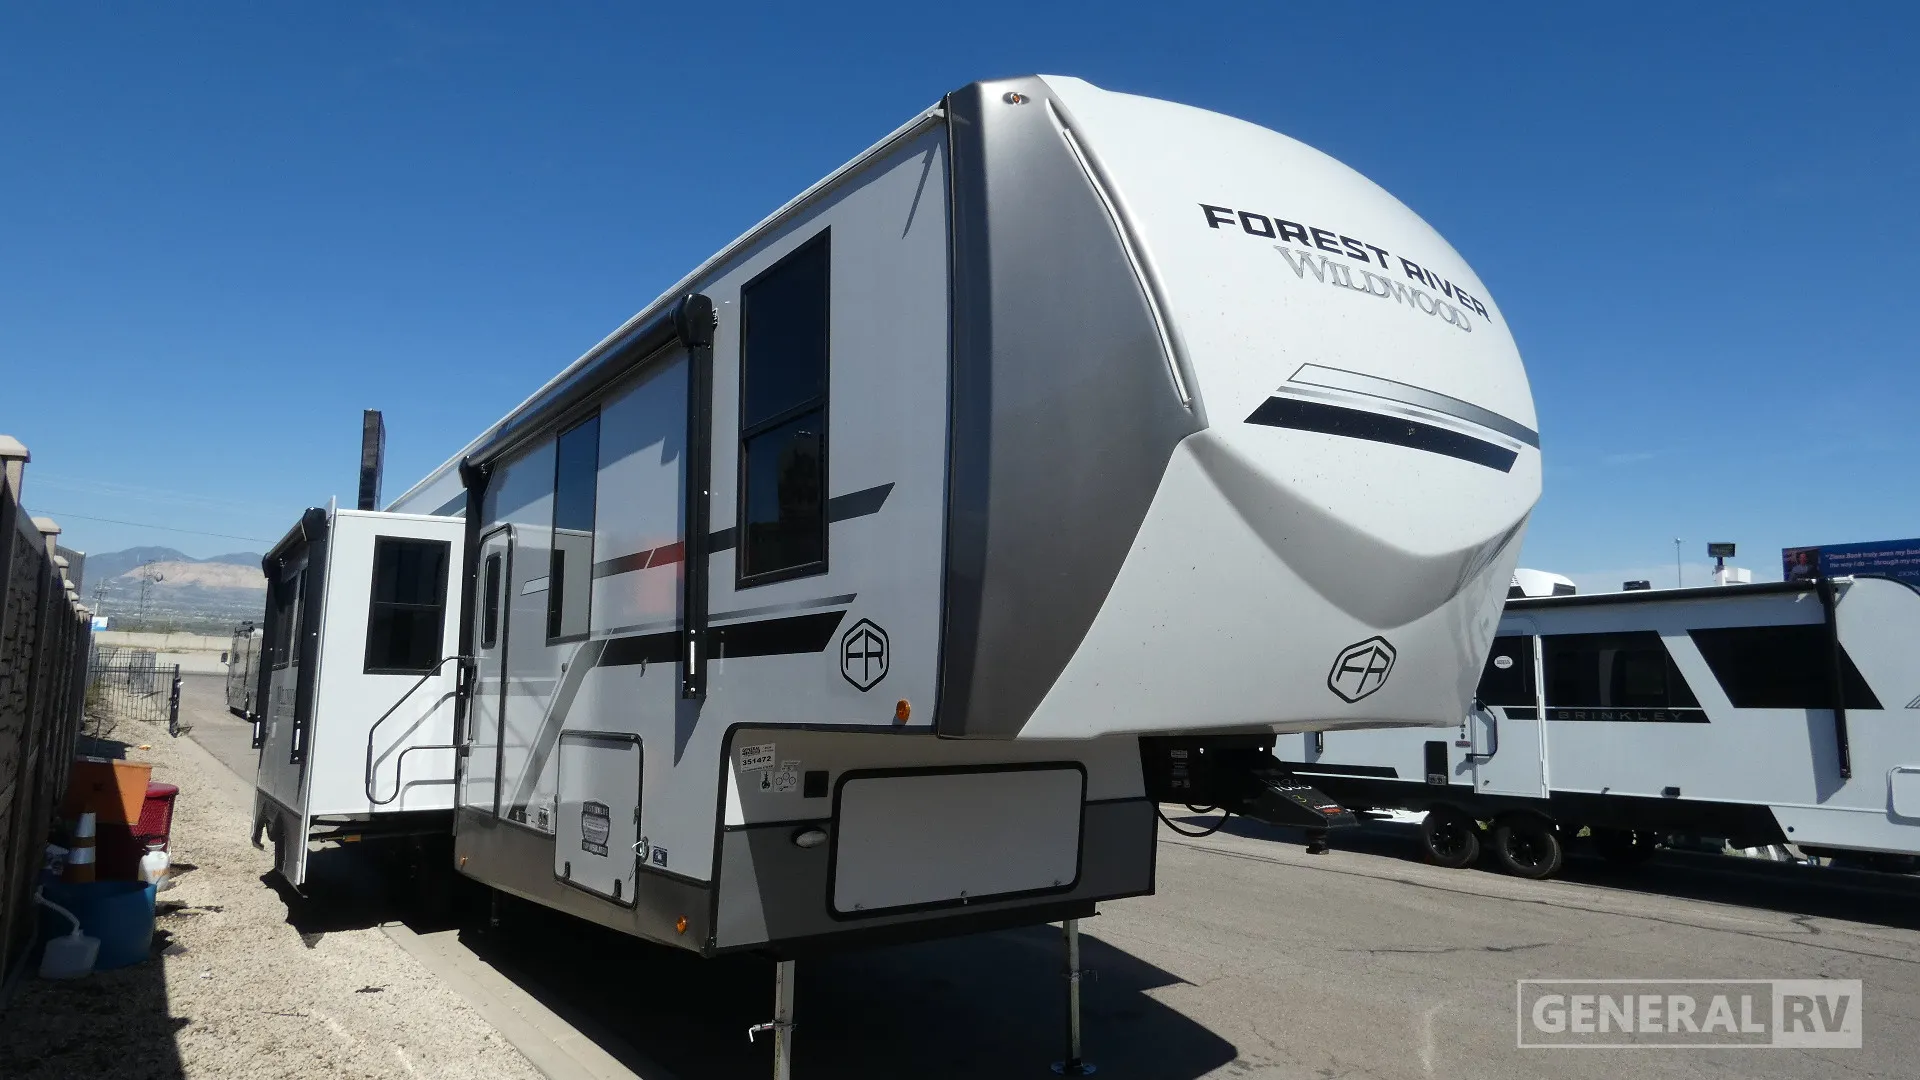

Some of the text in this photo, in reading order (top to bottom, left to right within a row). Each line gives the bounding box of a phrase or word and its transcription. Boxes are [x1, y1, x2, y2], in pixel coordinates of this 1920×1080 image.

[1198, 203, 1493, 324] FOREST RIVER
[1273, 245, 1473, 334] WILDWOOD
[1557, 711, 1684, 721] BRINKLEY
[742, 755, 772, 766] 351472
